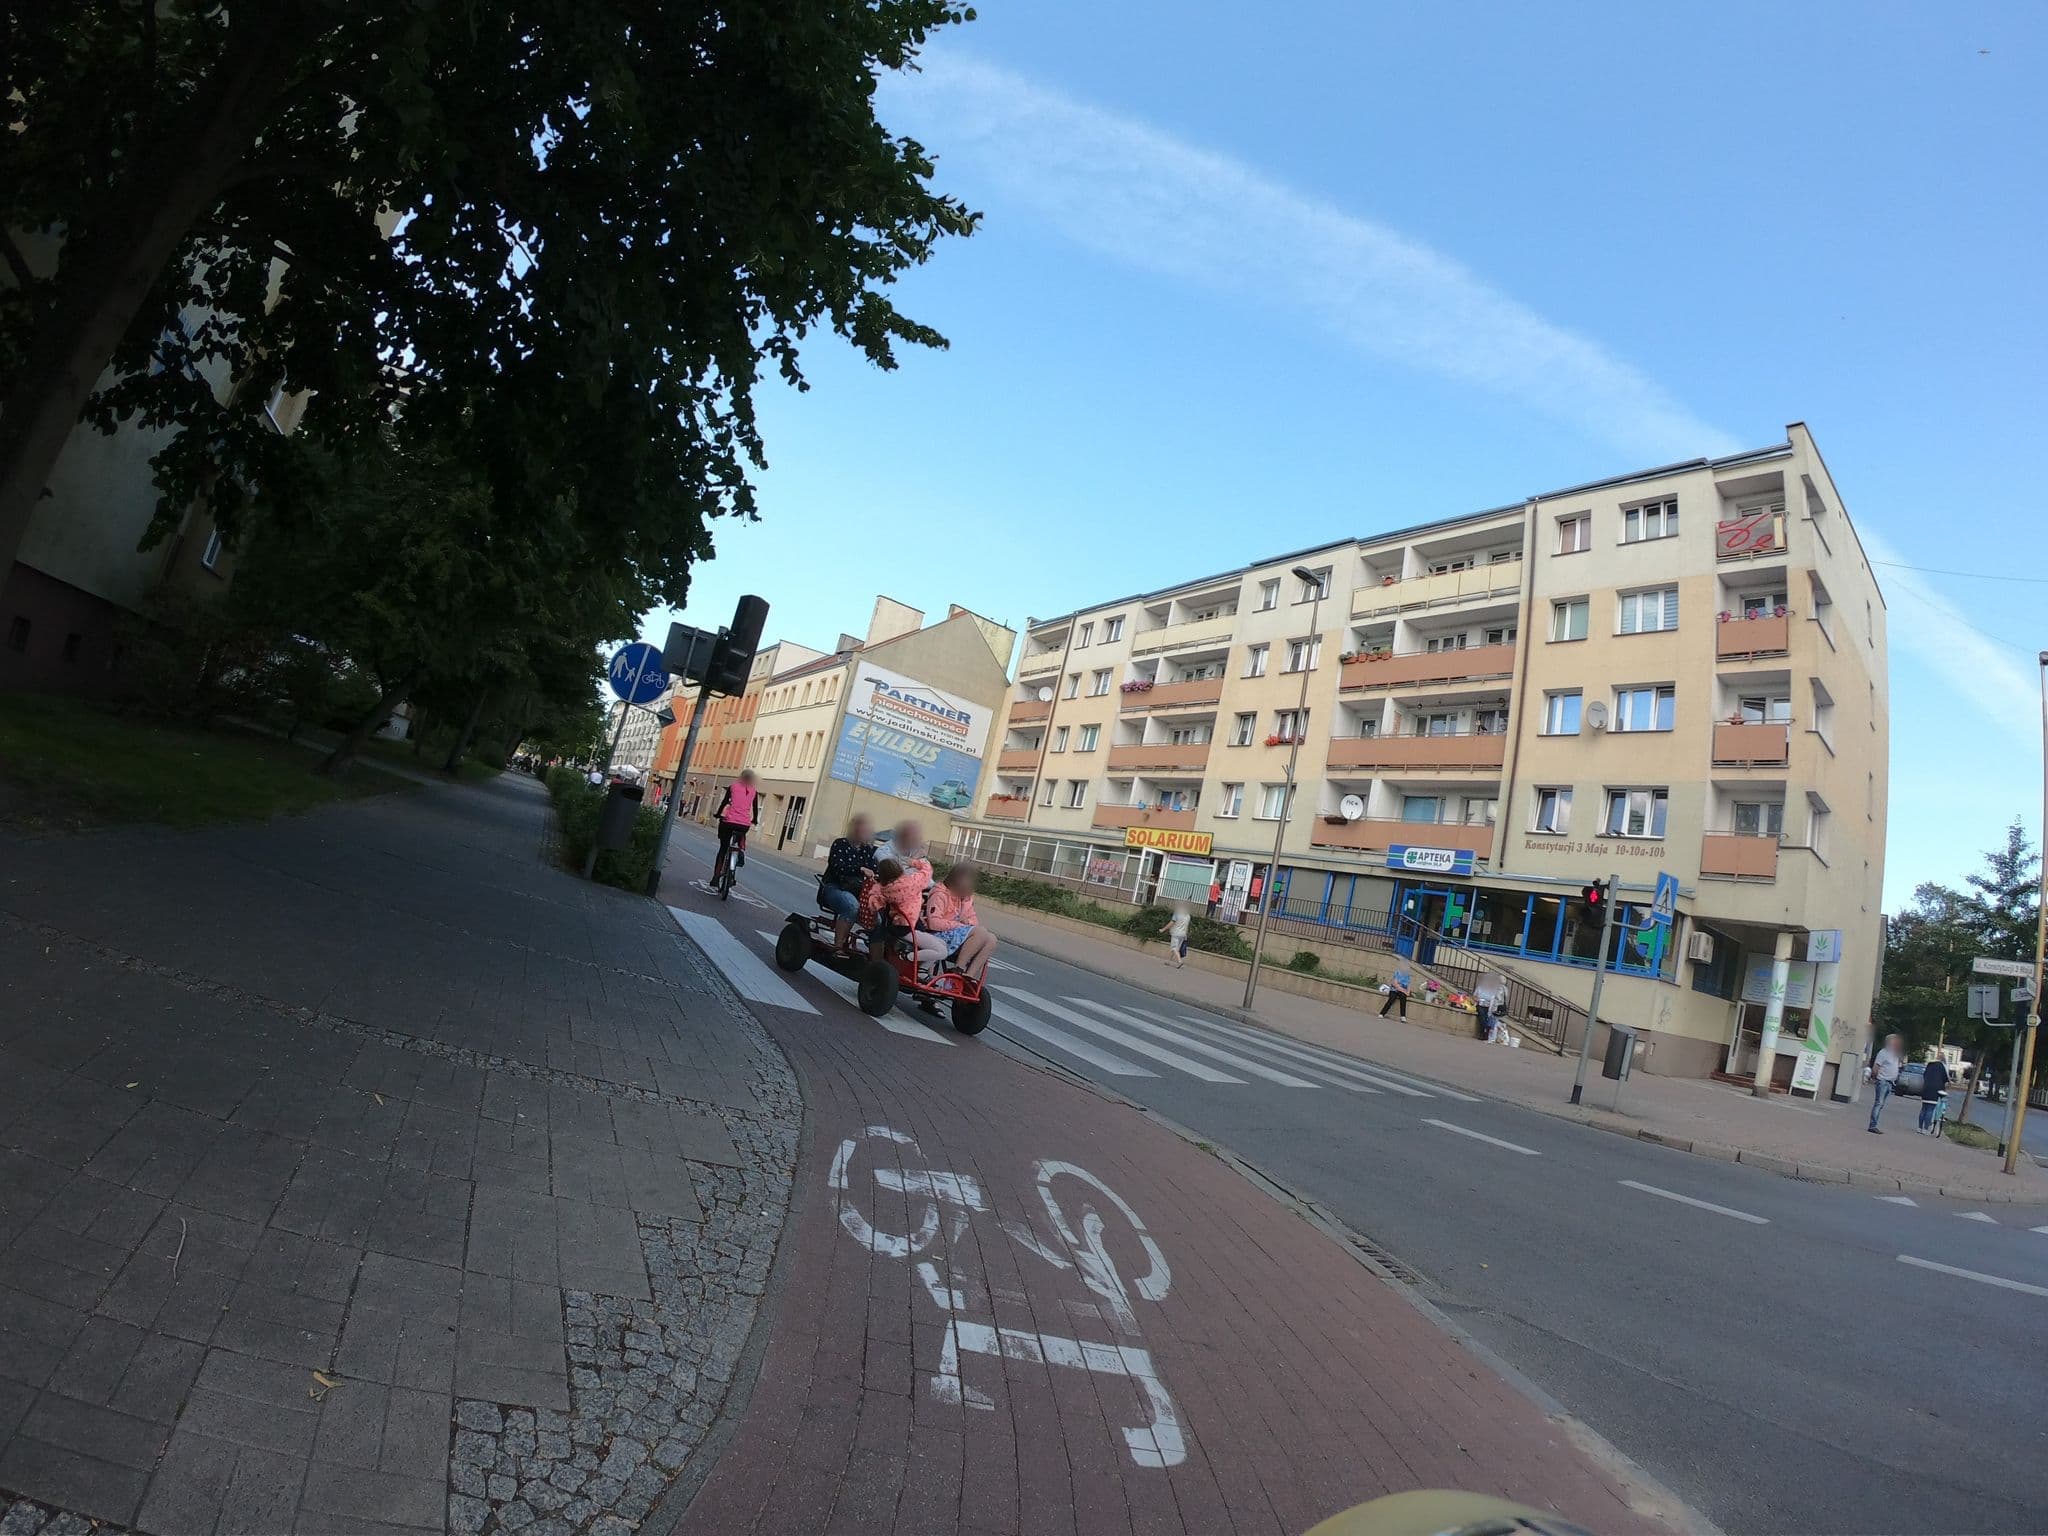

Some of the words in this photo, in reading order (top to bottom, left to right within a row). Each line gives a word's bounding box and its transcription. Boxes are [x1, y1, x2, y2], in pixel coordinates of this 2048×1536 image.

[874, 680, 972, 725] PARTNER
[846, 721, 942, 763] EMILBUS
[856, 707, 977, 755] www.jedlinski.com.pl
[1127, 829, 1210, 852] SOLARIUM
[1524, 839, 1575, 854] Konstytucji
[1576, 842, 1583, 853] 3
[1584, 843, 1609, 857] Maja
[1417, 851, 1451, 863] APTEKA
